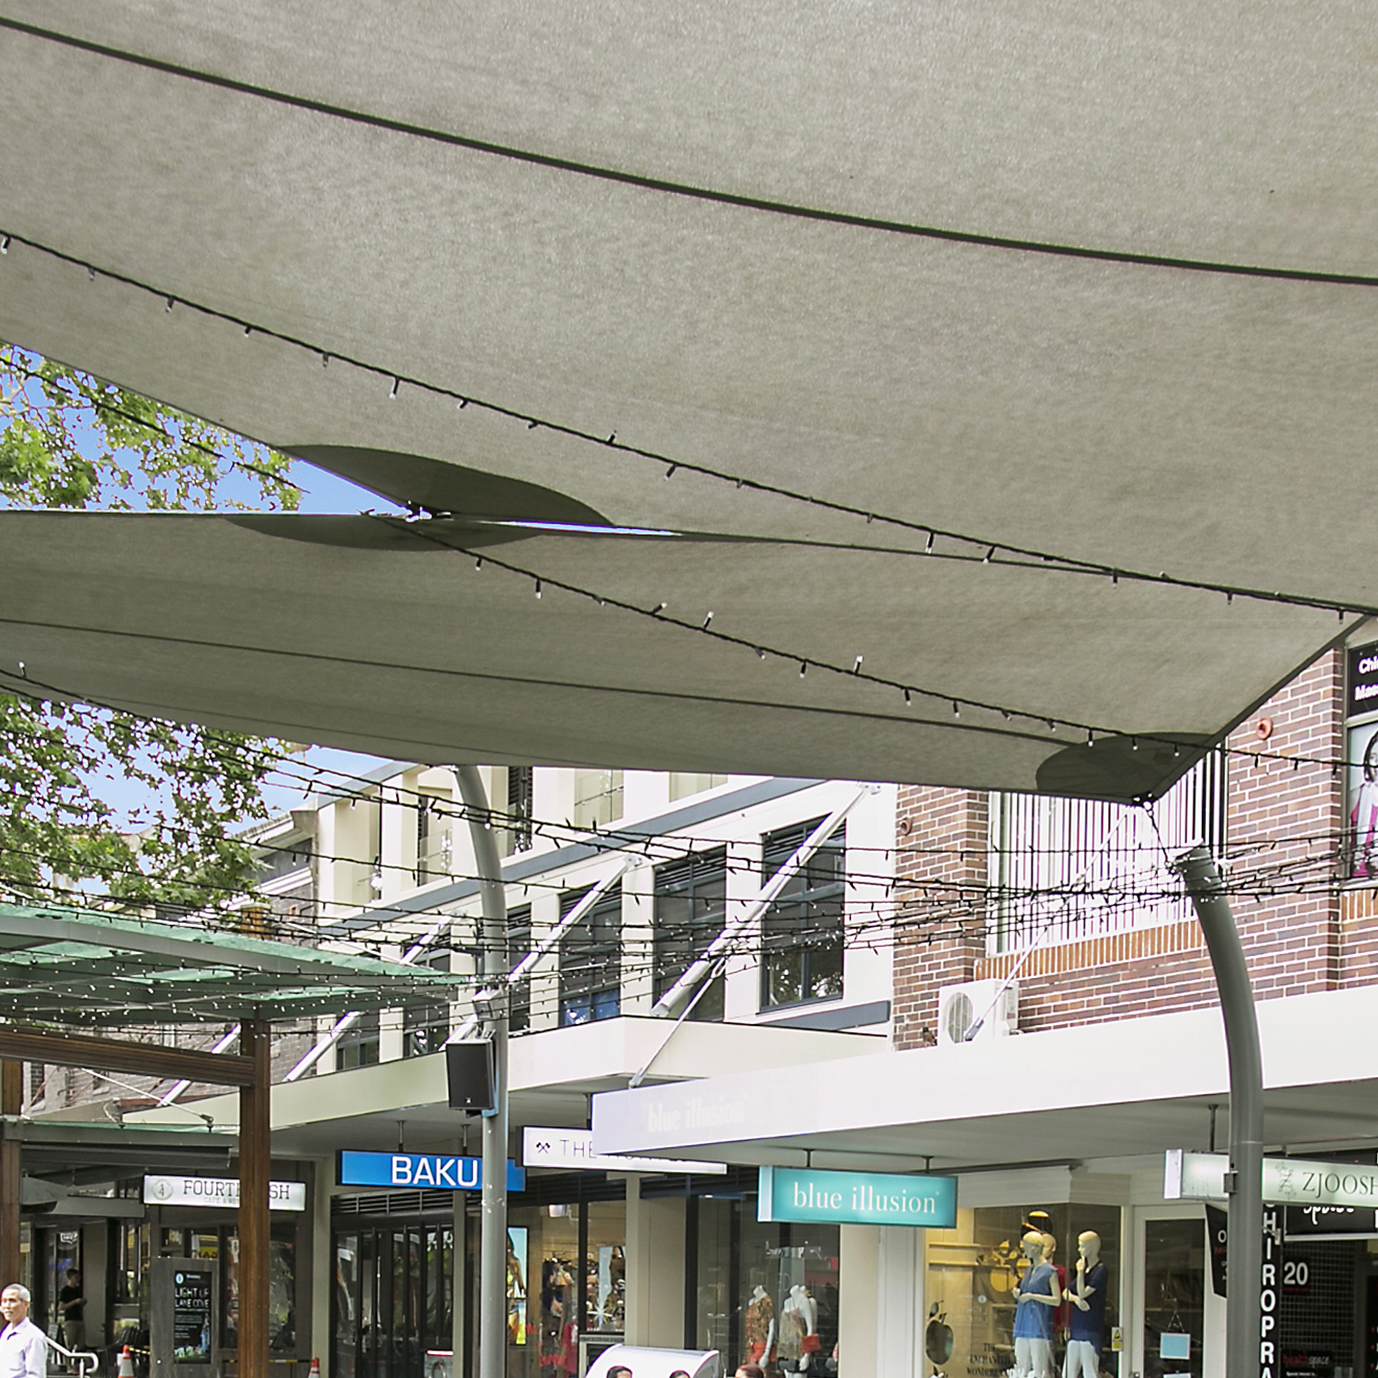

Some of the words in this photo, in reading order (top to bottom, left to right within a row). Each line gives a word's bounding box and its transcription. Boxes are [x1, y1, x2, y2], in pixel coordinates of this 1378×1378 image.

[648, 1102, 681, 1133] blue
[685, 1097, 745, 1130] illusion
[391, 1156, 478, 1186] BAKU
[268, 1184, 290, 1200] SH
[793, 1181, 843, 1210] blue
[851, 1184, 936, 1214] illusion
[1283, 1261, 1309, 1286] 20
